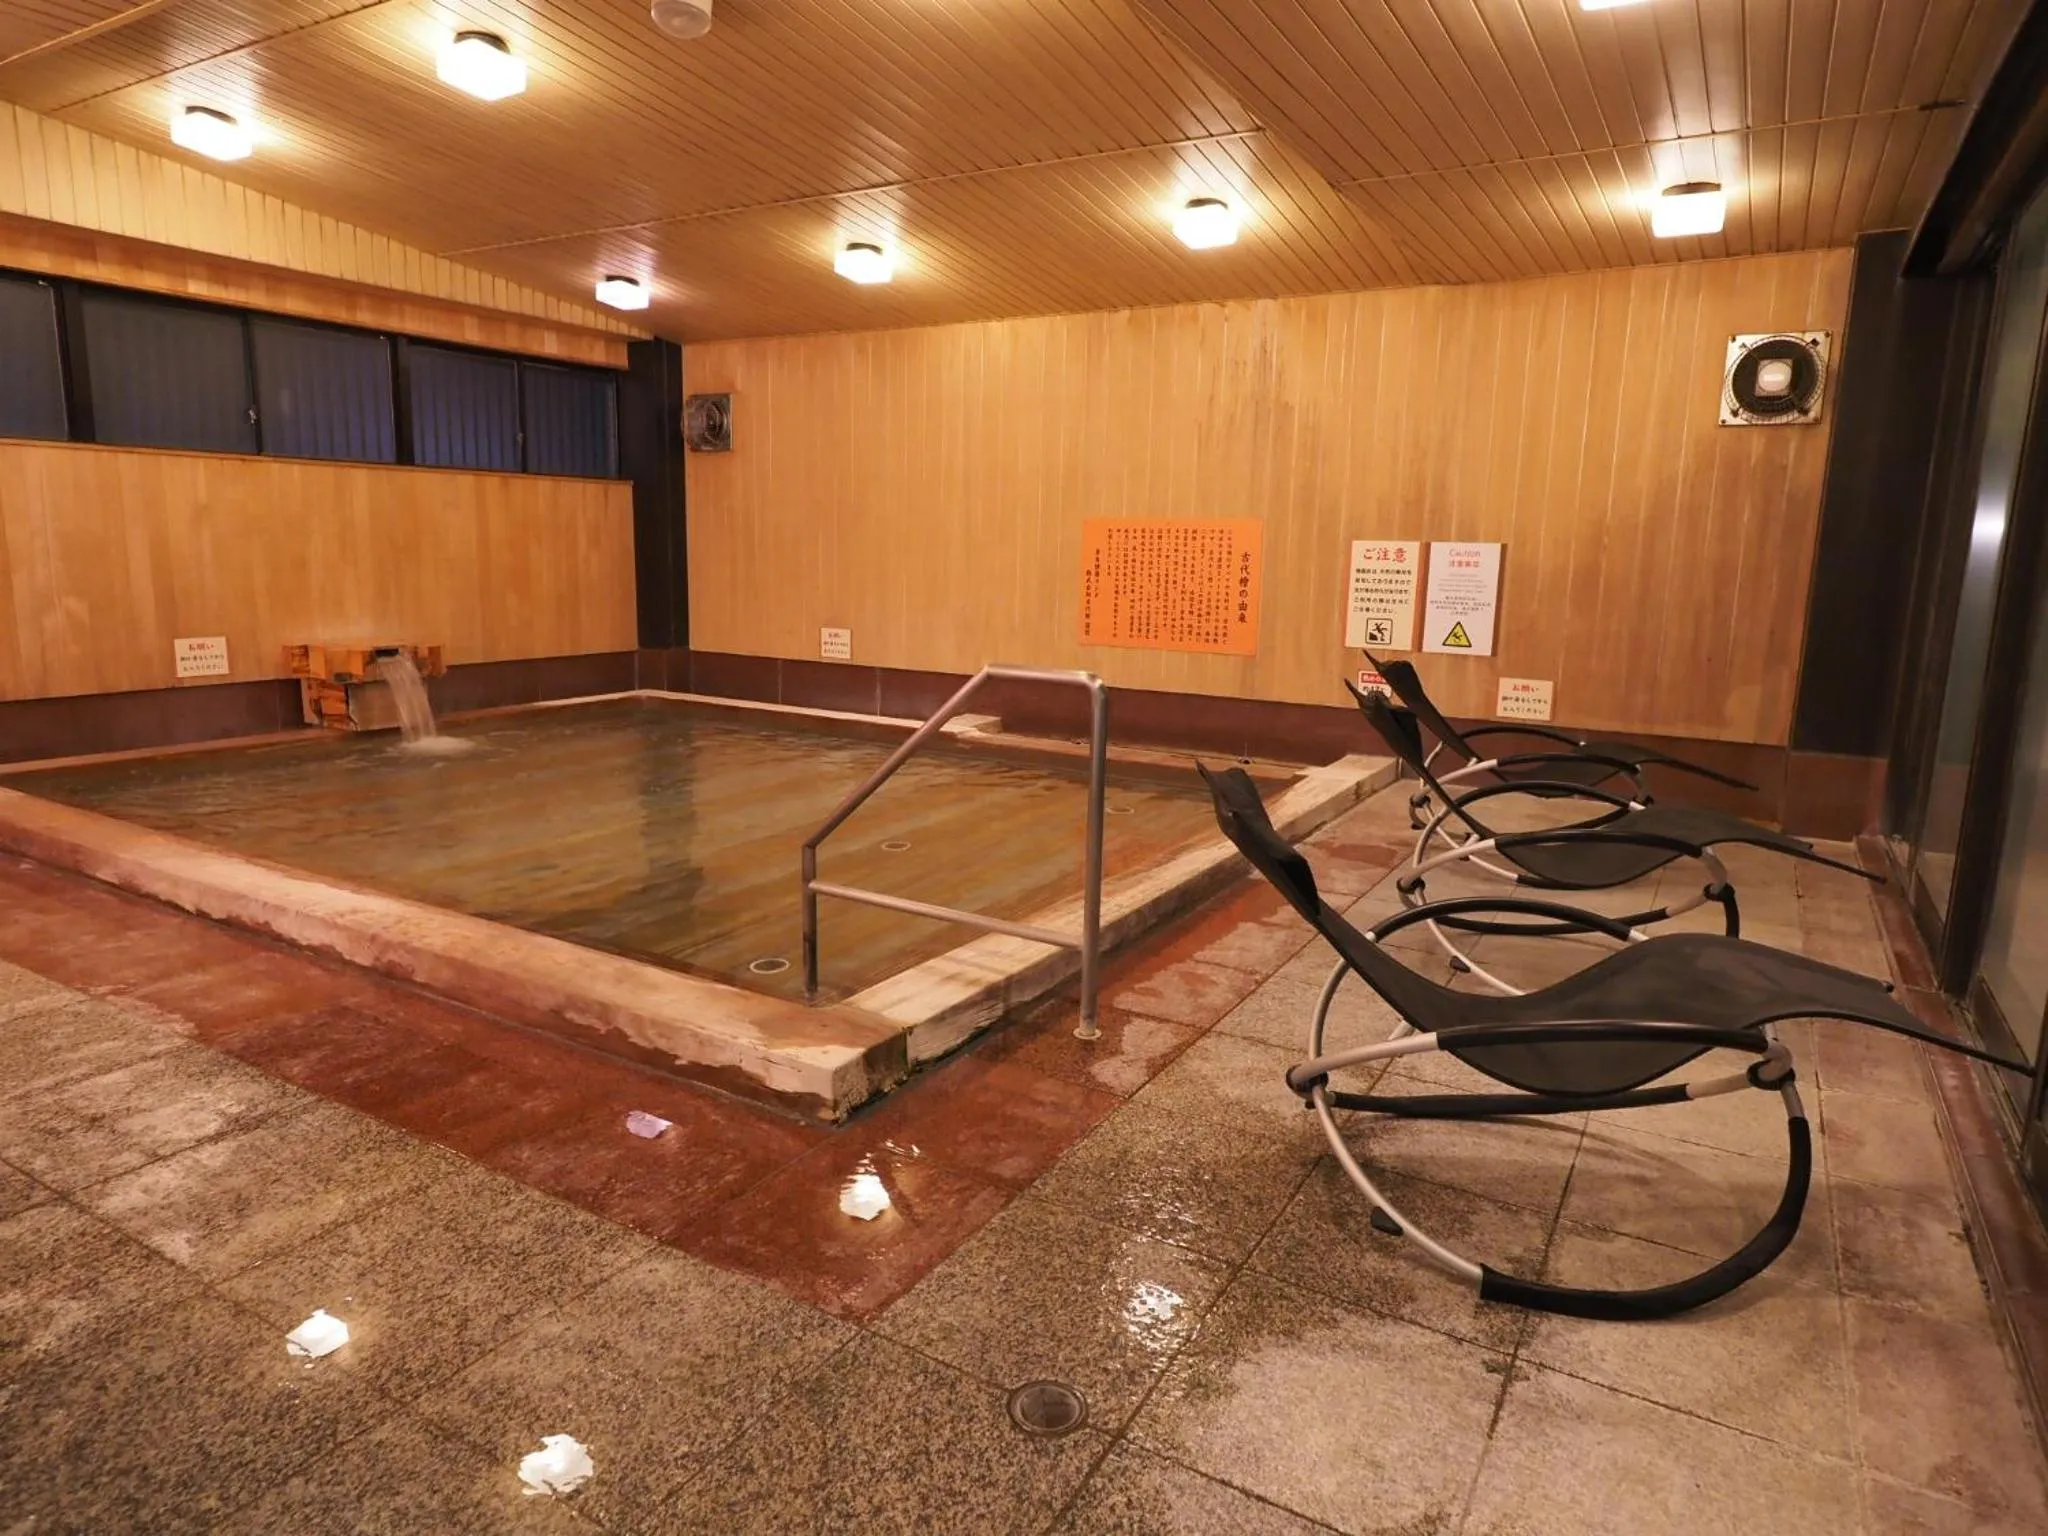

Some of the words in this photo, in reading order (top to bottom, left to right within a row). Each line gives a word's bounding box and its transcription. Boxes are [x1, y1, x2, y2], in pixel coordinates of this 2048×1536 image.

[1363, 547, 1408, 563] ご注意
[1512, 684, 1540, 693] お願い
